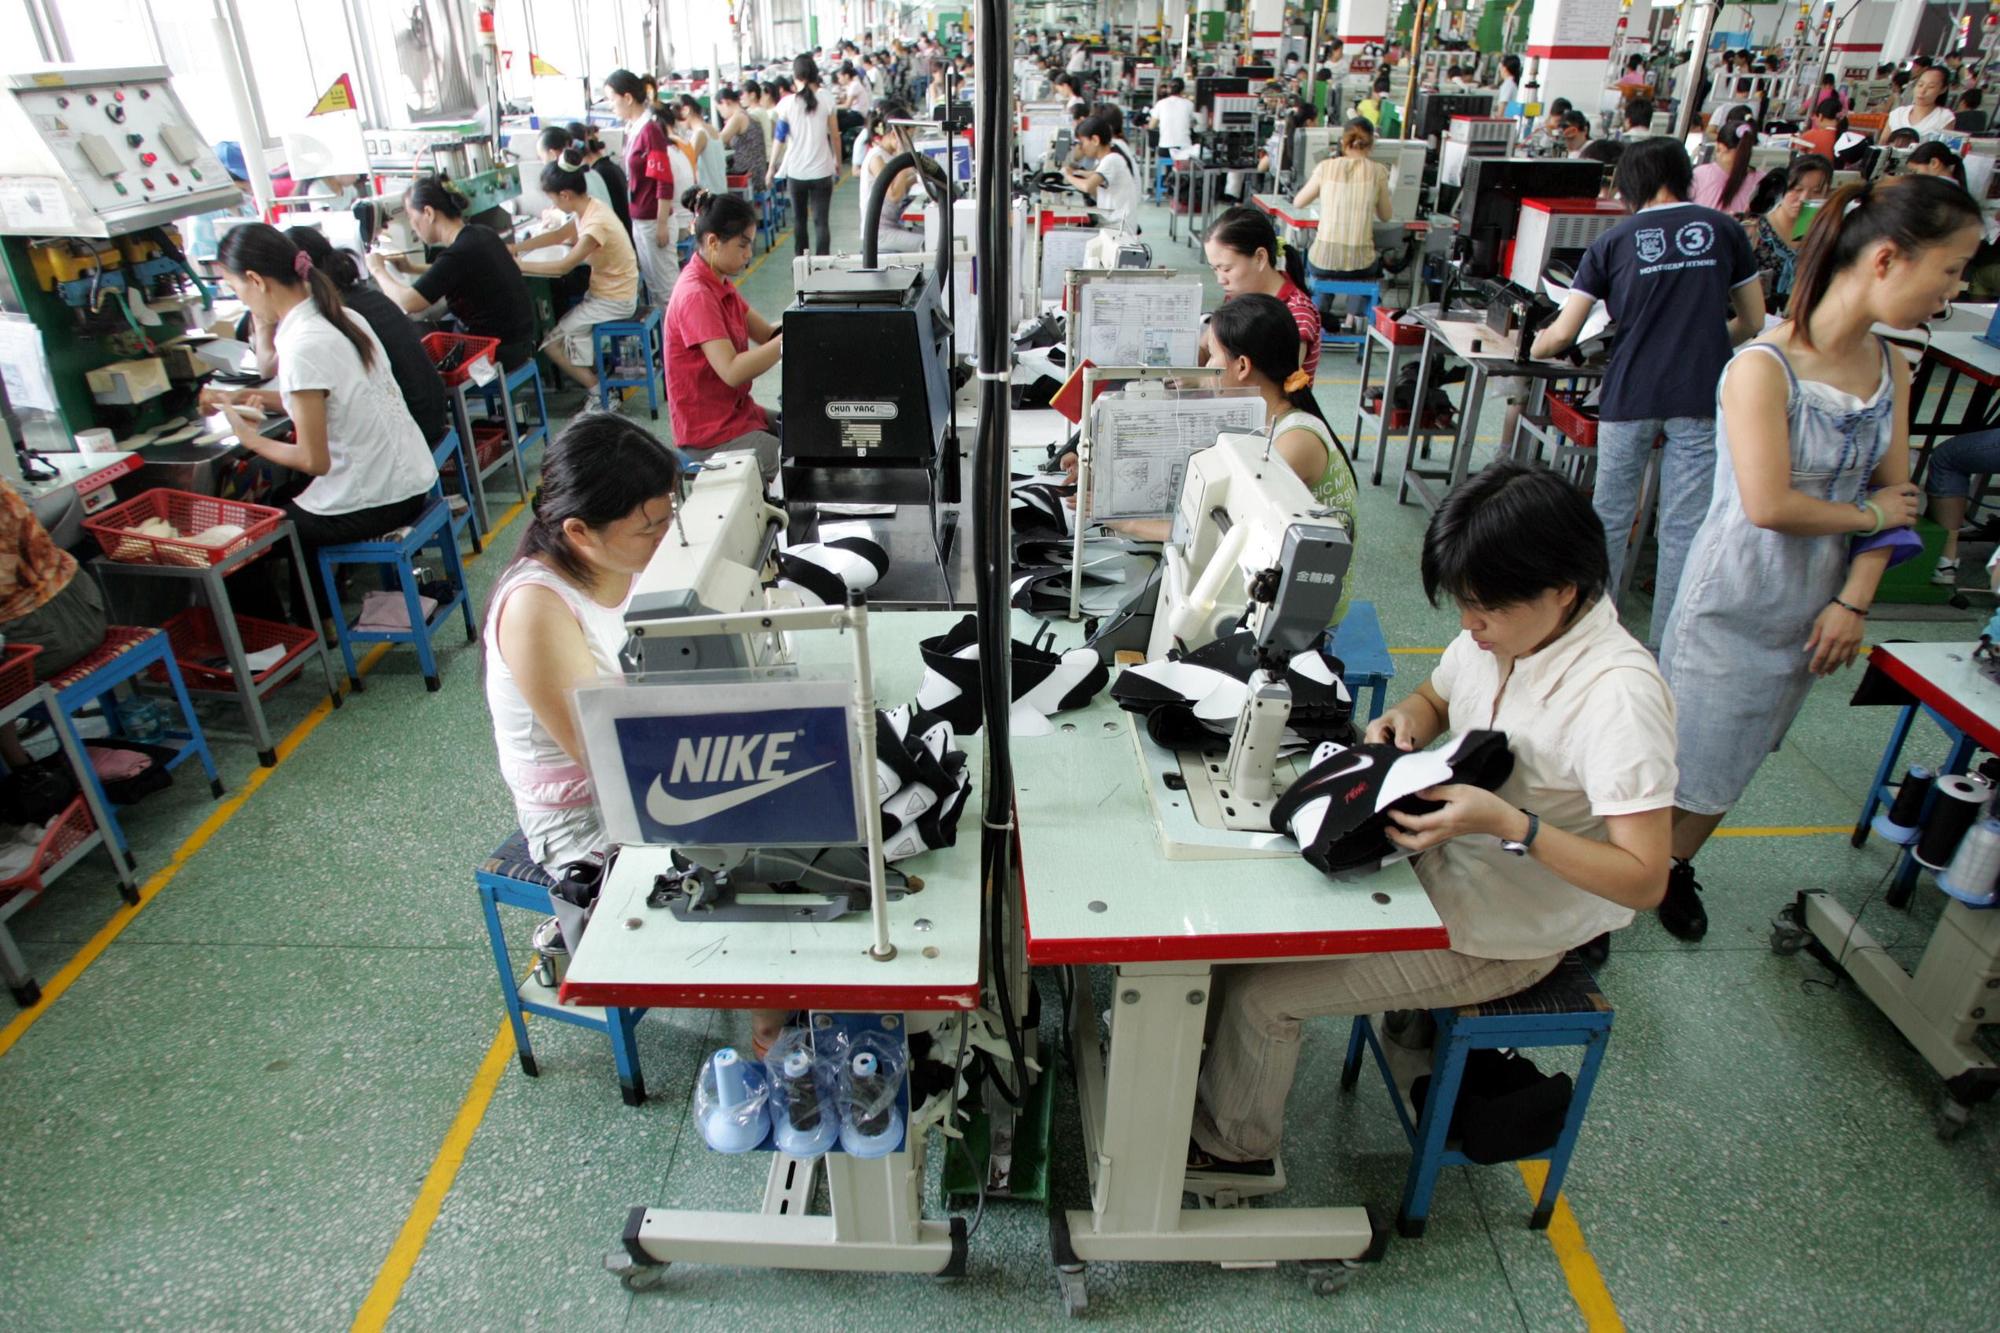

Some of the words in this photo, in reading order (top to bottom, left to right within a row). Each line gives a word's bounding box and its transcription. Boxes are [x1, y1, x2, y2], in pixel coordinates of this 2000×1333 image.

[501, 50, 513, 69] 7
[1684, 227, 1705, 250] 3
[829, 405, 851, 413] CHUN
[853, 405, 875, 413] YANG
[669, 731, 797, 784] NIKE
